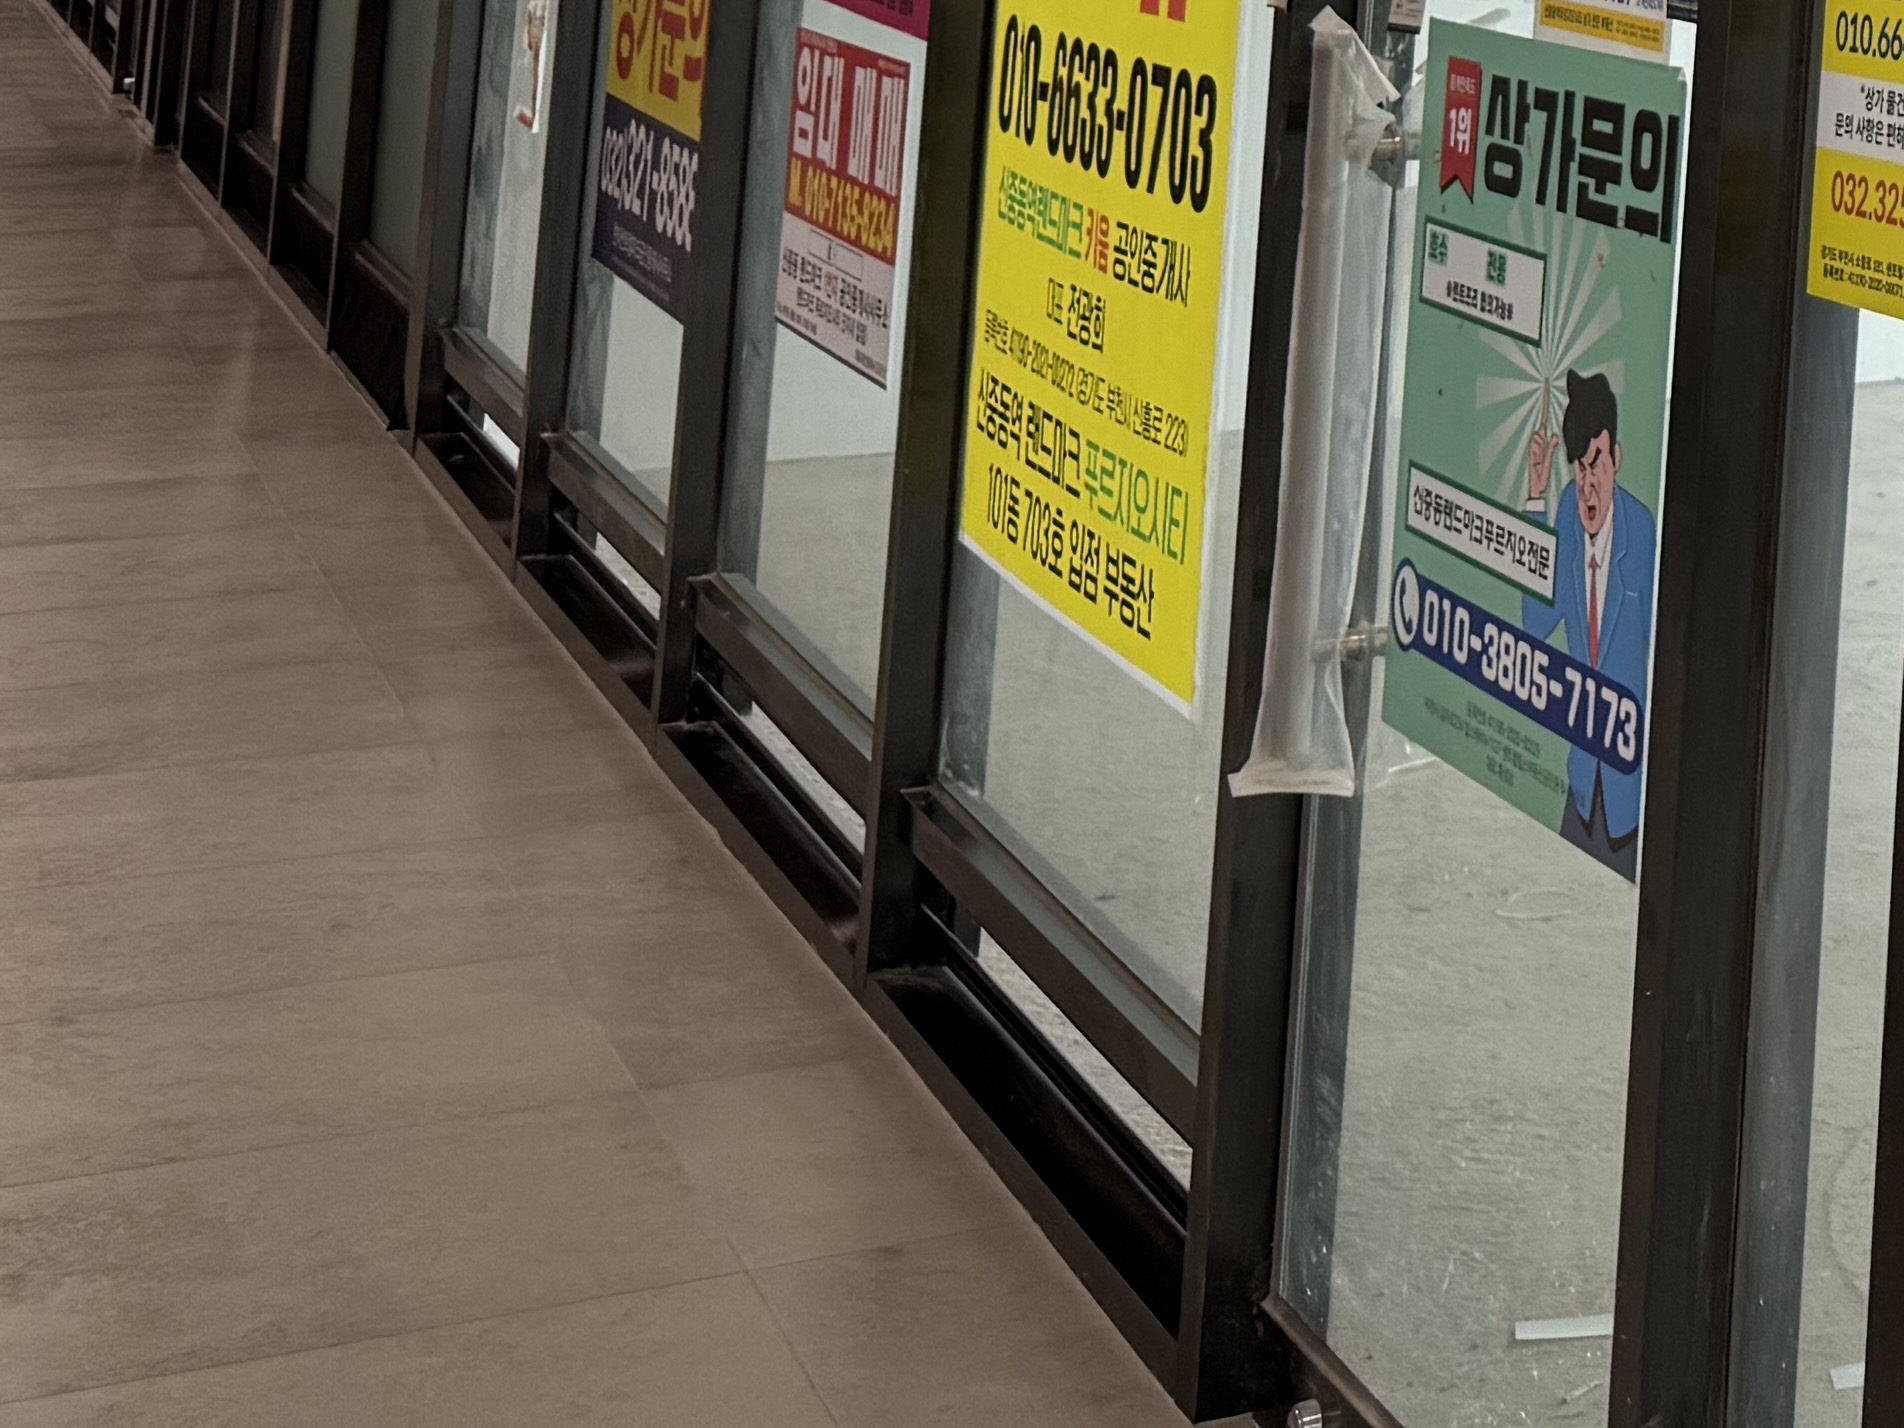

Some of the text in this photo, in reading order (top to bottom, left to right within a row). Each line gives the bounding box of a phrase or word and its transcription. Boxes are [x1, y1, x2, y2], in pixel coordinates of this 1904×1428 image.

[792, 46, 904, 197] 임대 매매
[999, 14, 1217, 213] 010-6633-0703
[1450, 107, 1472, 156] 1위
[1484, 74, 1680, 244] 상가문의
[1834, 112, 1854, 141] 문의
[1855, 115, 1884, 144] 사항은
[1113, 221, 1191, 308] 공인중개사
[977, 368, 1024, 461] 신중동역
[1084, 438, 1188, 565] 푸르지오시티
[987, 462, 1154, 640] 101동 703호 입점 부동산
[1422, 588, 1639, 762] 010-3805-7173
